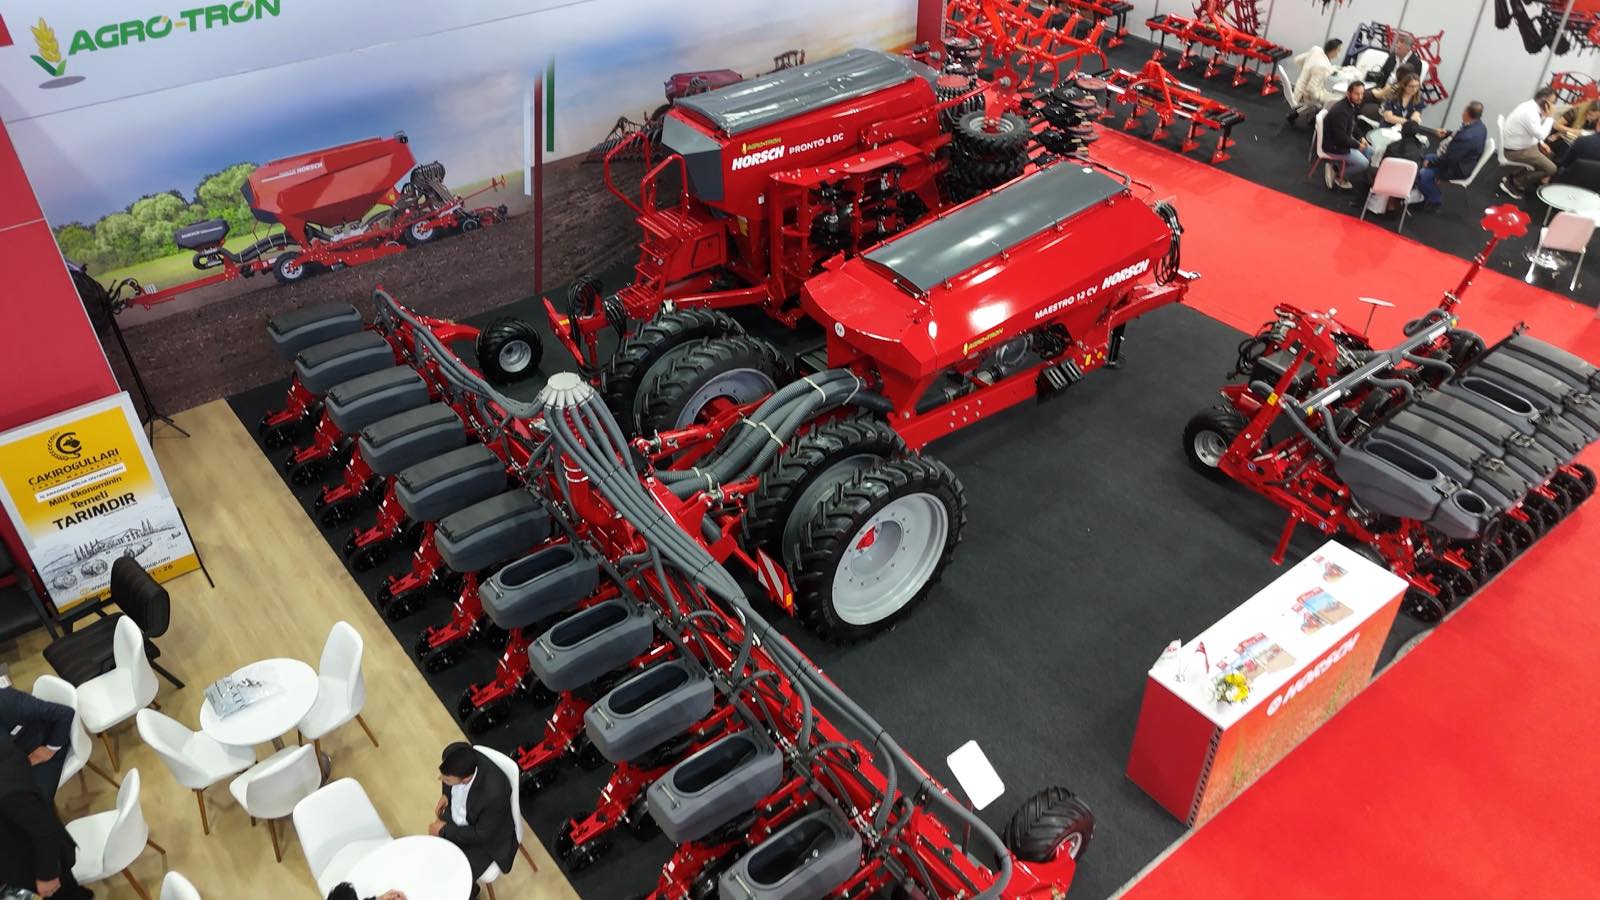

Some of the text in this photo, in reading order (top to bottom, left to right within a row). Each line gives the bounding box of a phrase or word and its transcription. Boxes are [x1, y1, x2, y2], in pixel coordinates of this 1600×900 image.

[68, 0, 281, 56] AGRO-TRON
[732, 132, 844, 170] HORSCH PRONTO 4 DC
[1035, 295, 1075, 320] MAESTRO
[1086, 285, 1098, 296] CV
[1102, 258, 1150, 290] HORSCH
[49, 476, 122, 507] Milli Ekonominin
[70, 490, 109, 509] Temeli
[53, 492, 136, 530] TARIMDIR
[1282, 631, 1361, 704] HORSCH
